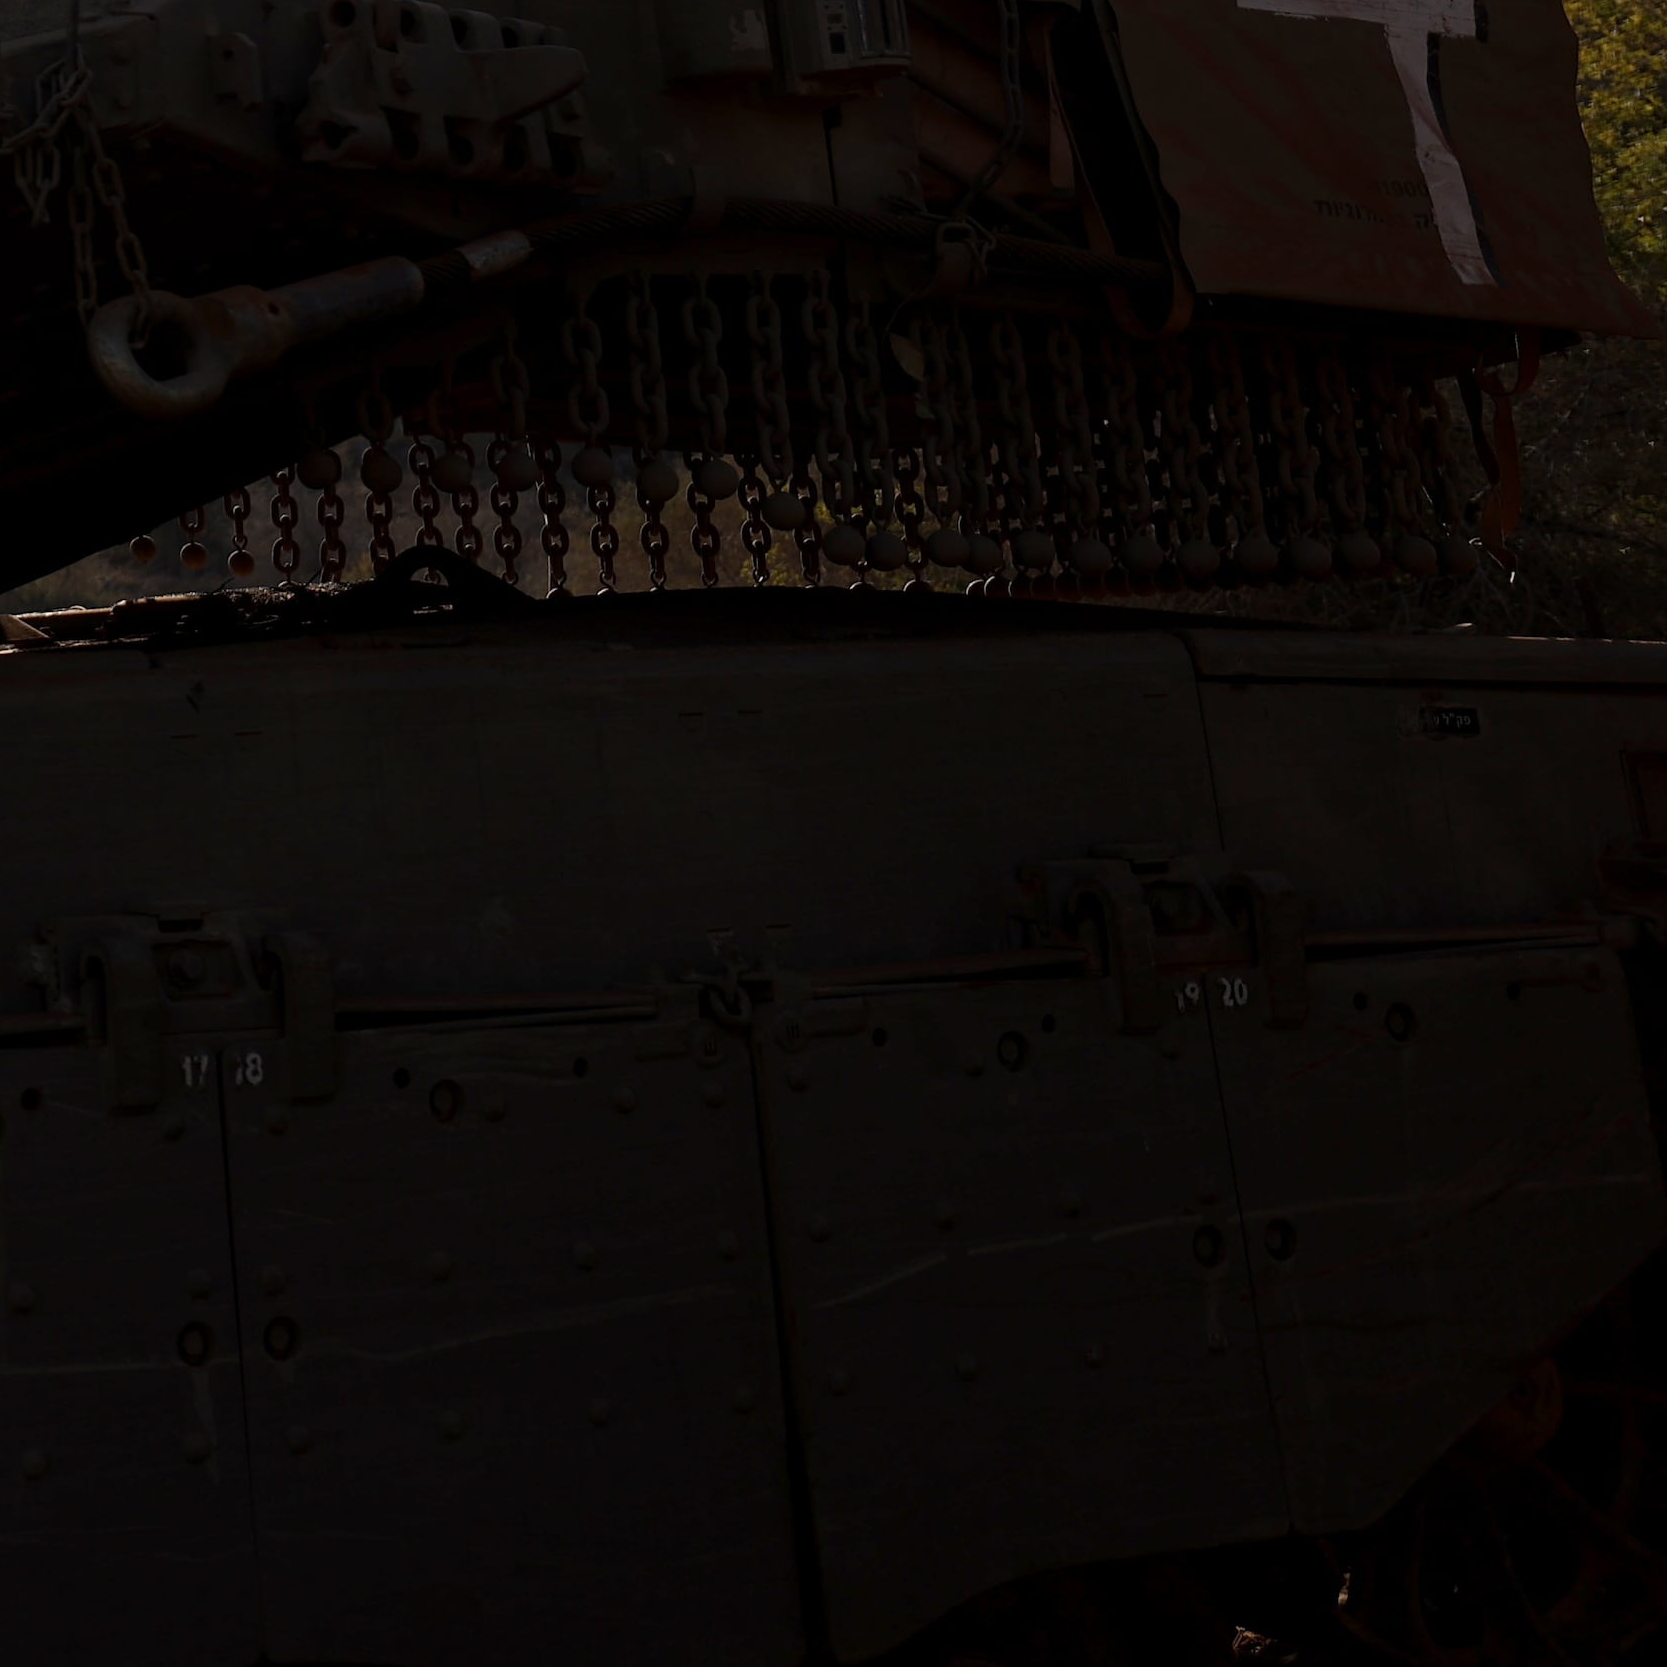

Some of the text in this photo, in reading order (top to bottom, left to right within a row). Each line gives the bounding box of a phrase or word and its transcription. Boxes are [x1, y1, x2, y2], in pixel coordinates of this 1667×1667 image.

[1173, 977, 1248, 1014] 19 20
[181, 1051, 263, 1087] 17 18
